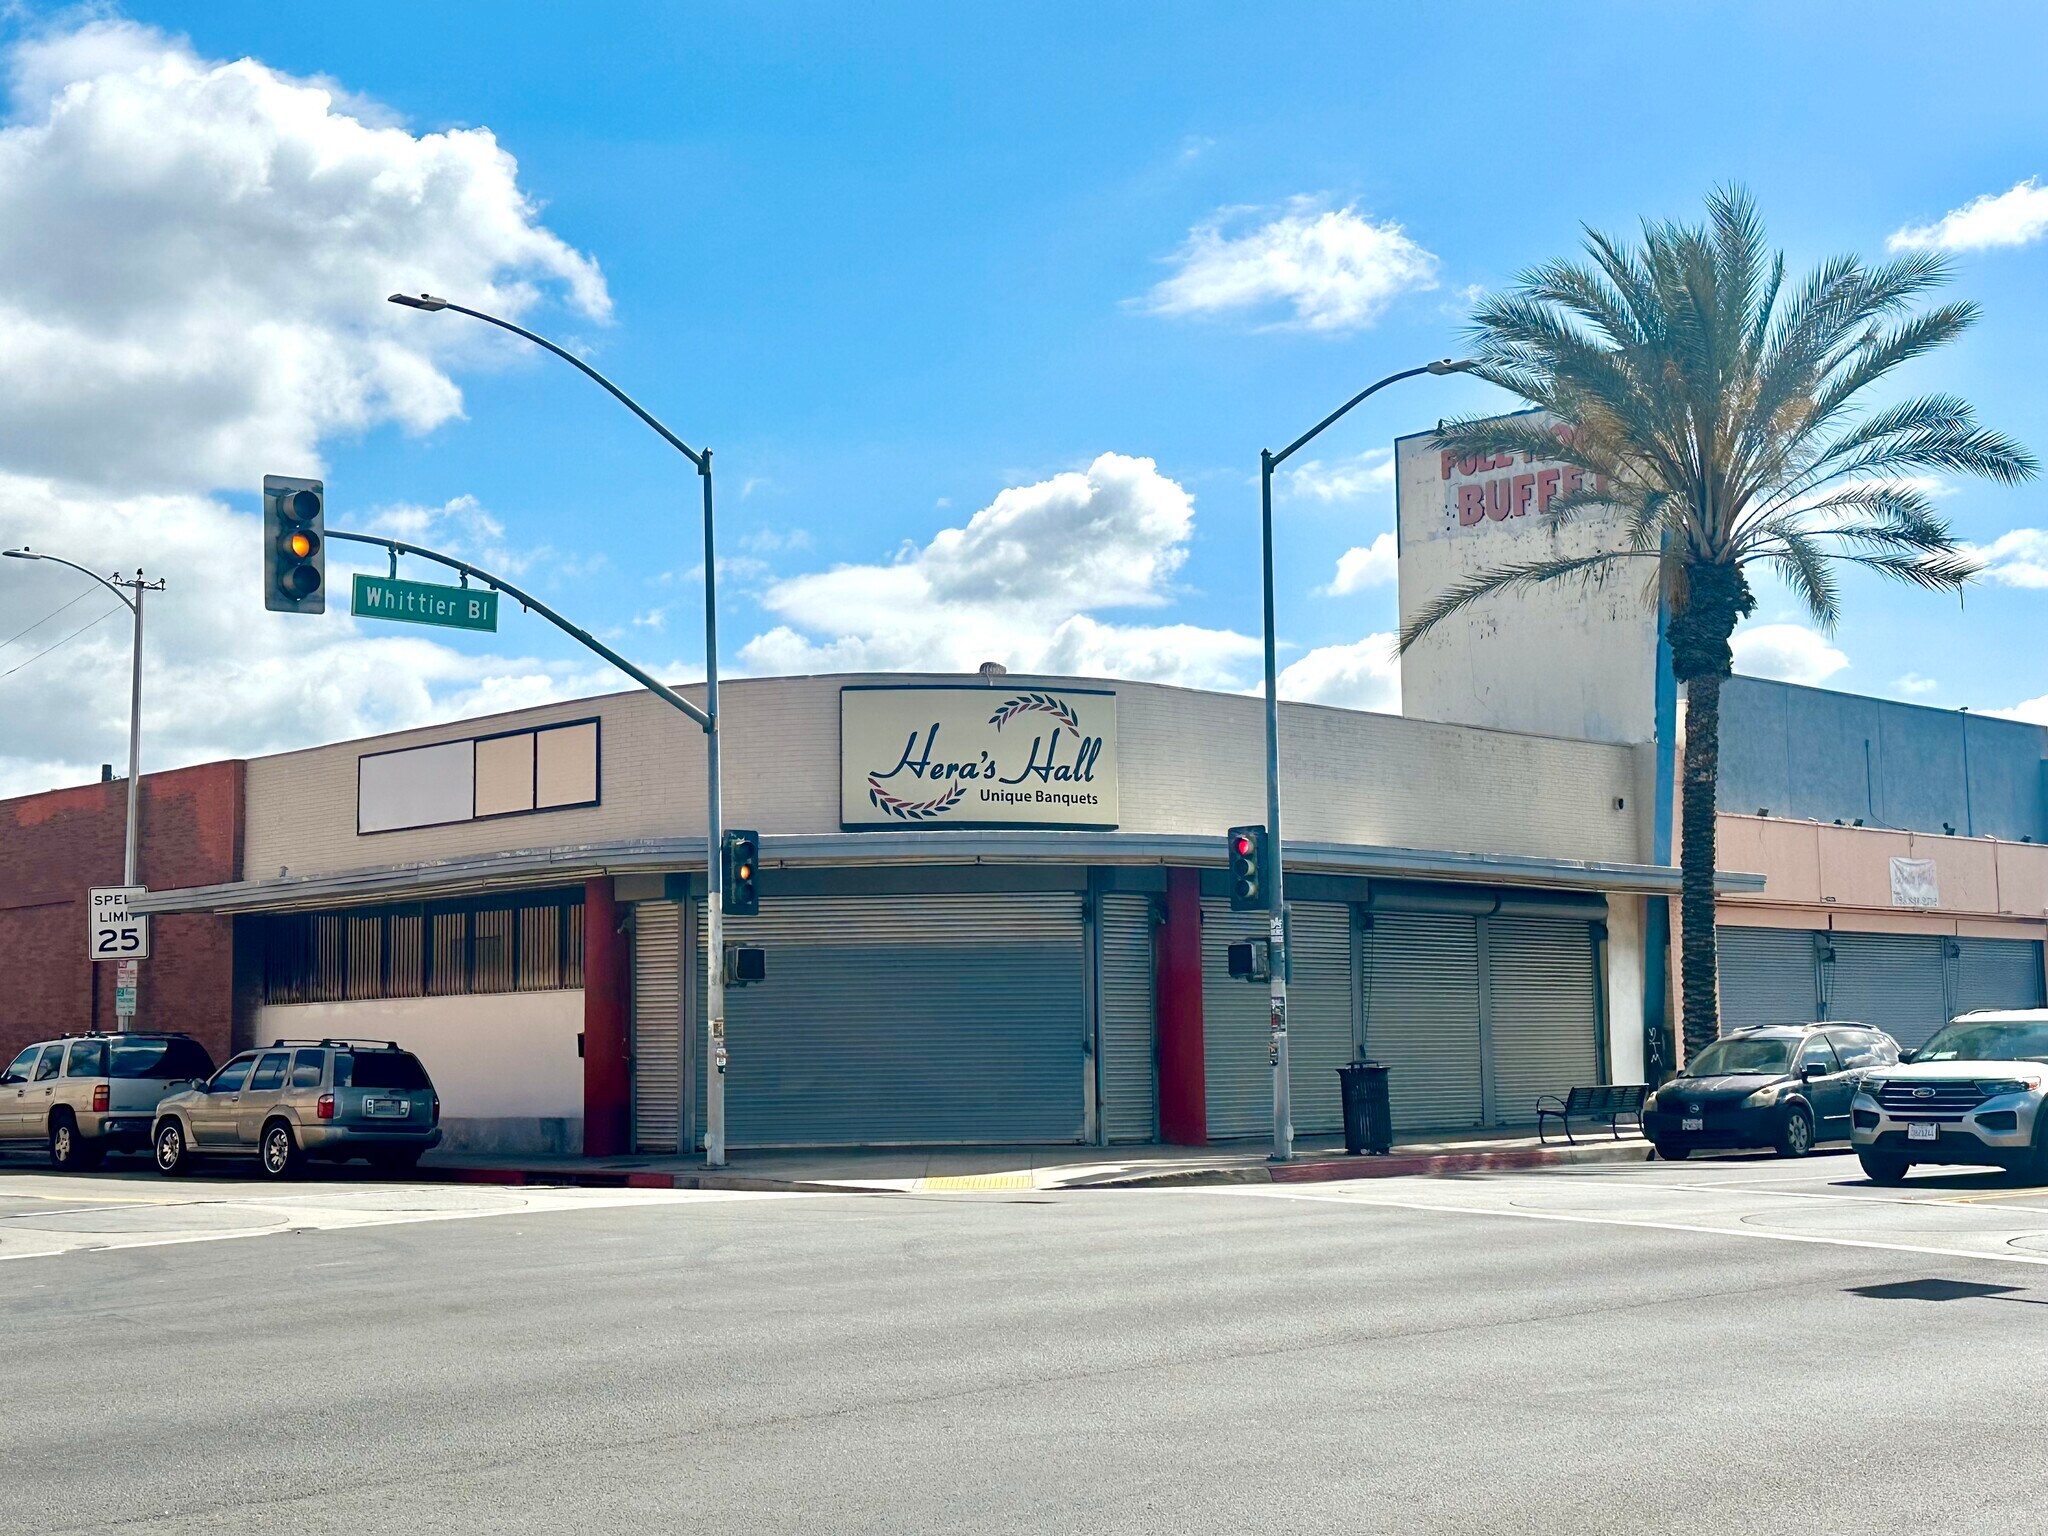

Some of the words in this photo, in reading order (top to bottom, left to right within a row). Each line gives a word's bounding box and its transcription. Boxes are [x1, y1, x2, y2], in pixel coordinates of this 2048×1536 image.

[366, 586, 456, 616] Whittier
[468, 599, 488, 620] Bl
[869, 722, 996, 780] Hera's
[998, 727, 1102, 784] Hall
[980, 788, 1032, 805] Unique
[1035, 790, 1098, 807] Banquets
[94, 894, 129, 906] SPE
[98, 928, 140, 952] 25
